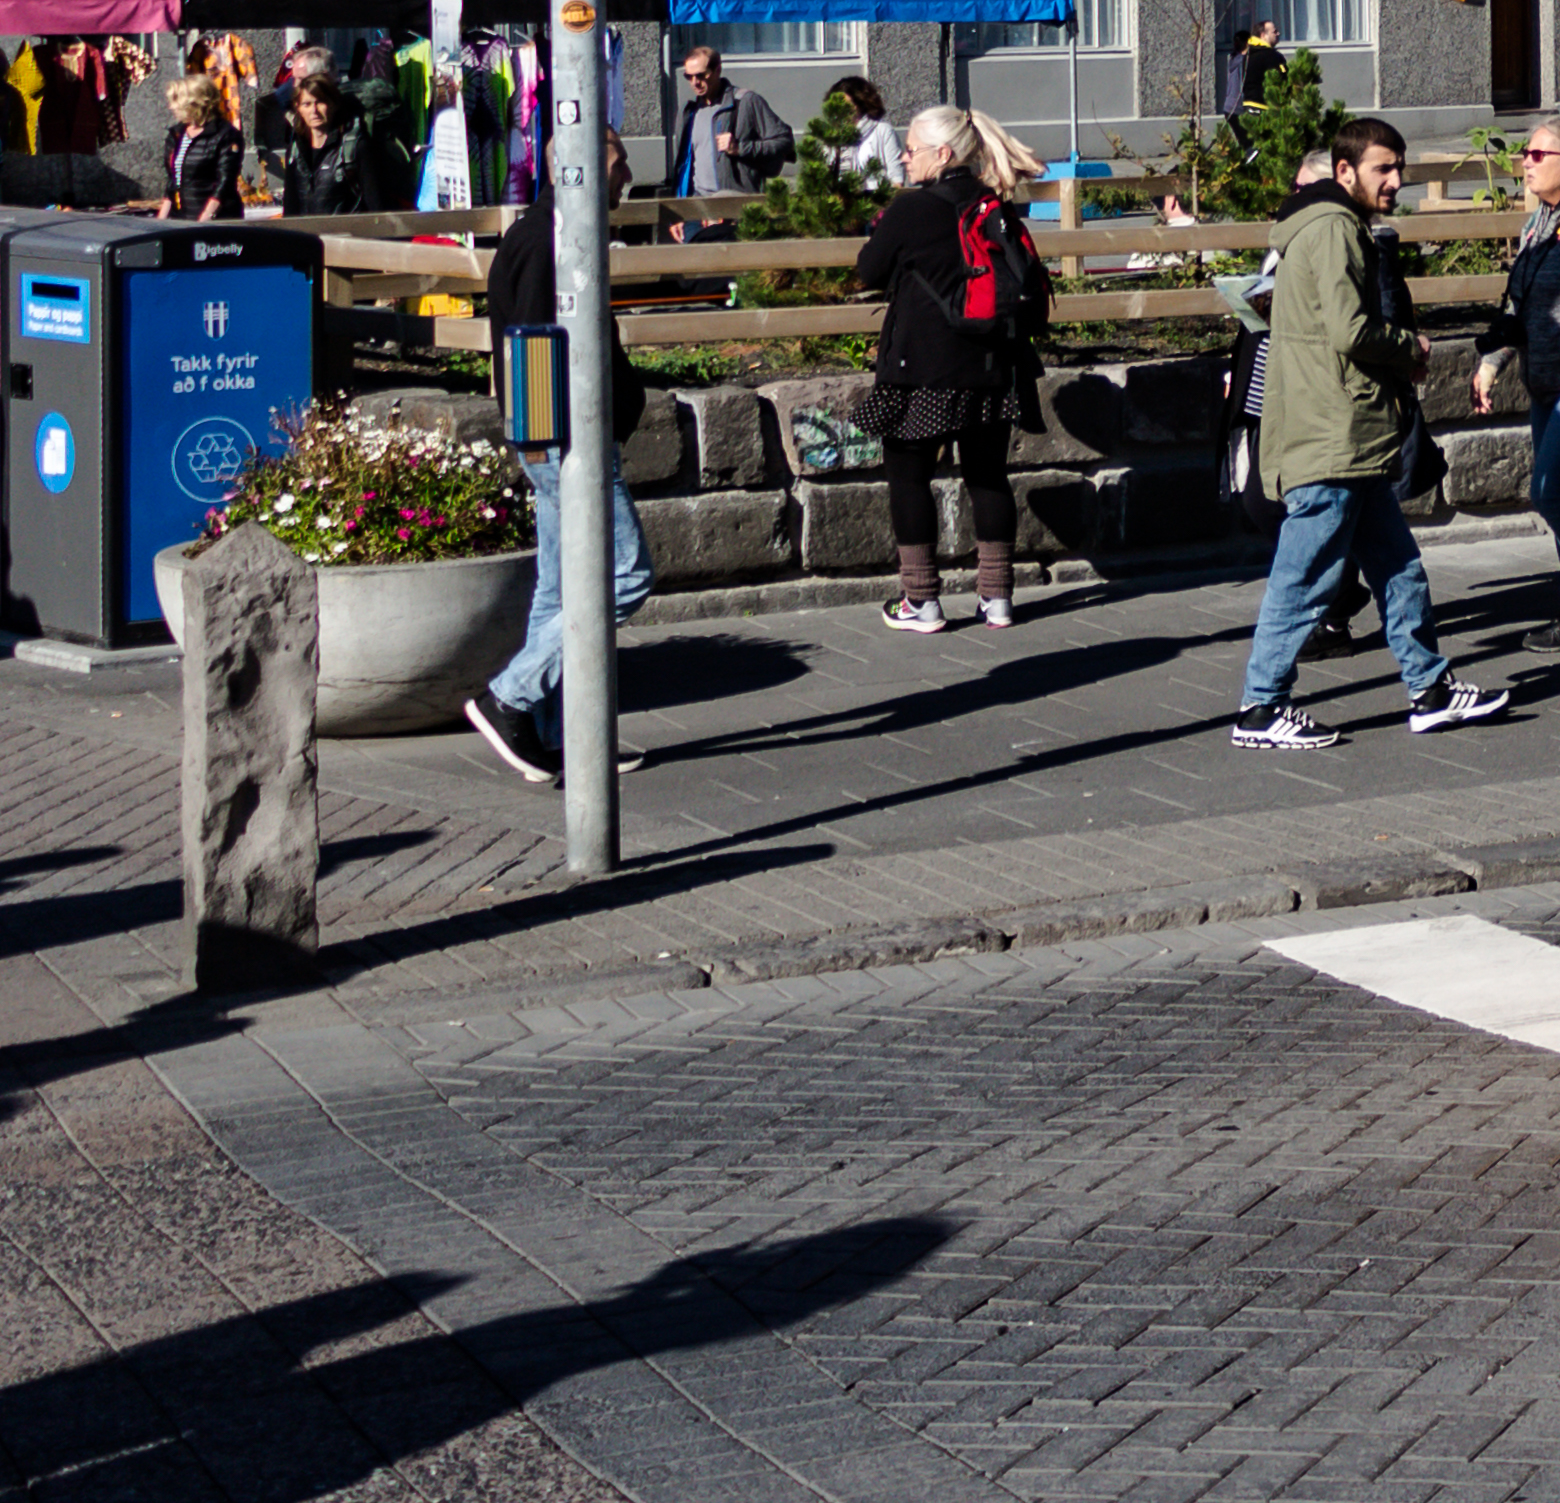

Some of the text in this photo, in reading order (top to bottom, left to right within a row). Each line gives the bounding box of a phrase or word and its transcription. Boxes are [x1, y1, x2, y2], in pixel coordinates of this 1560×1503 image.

[170, 351, 259, 374] Takk fyrir
[172, 375, 196, 394] að
